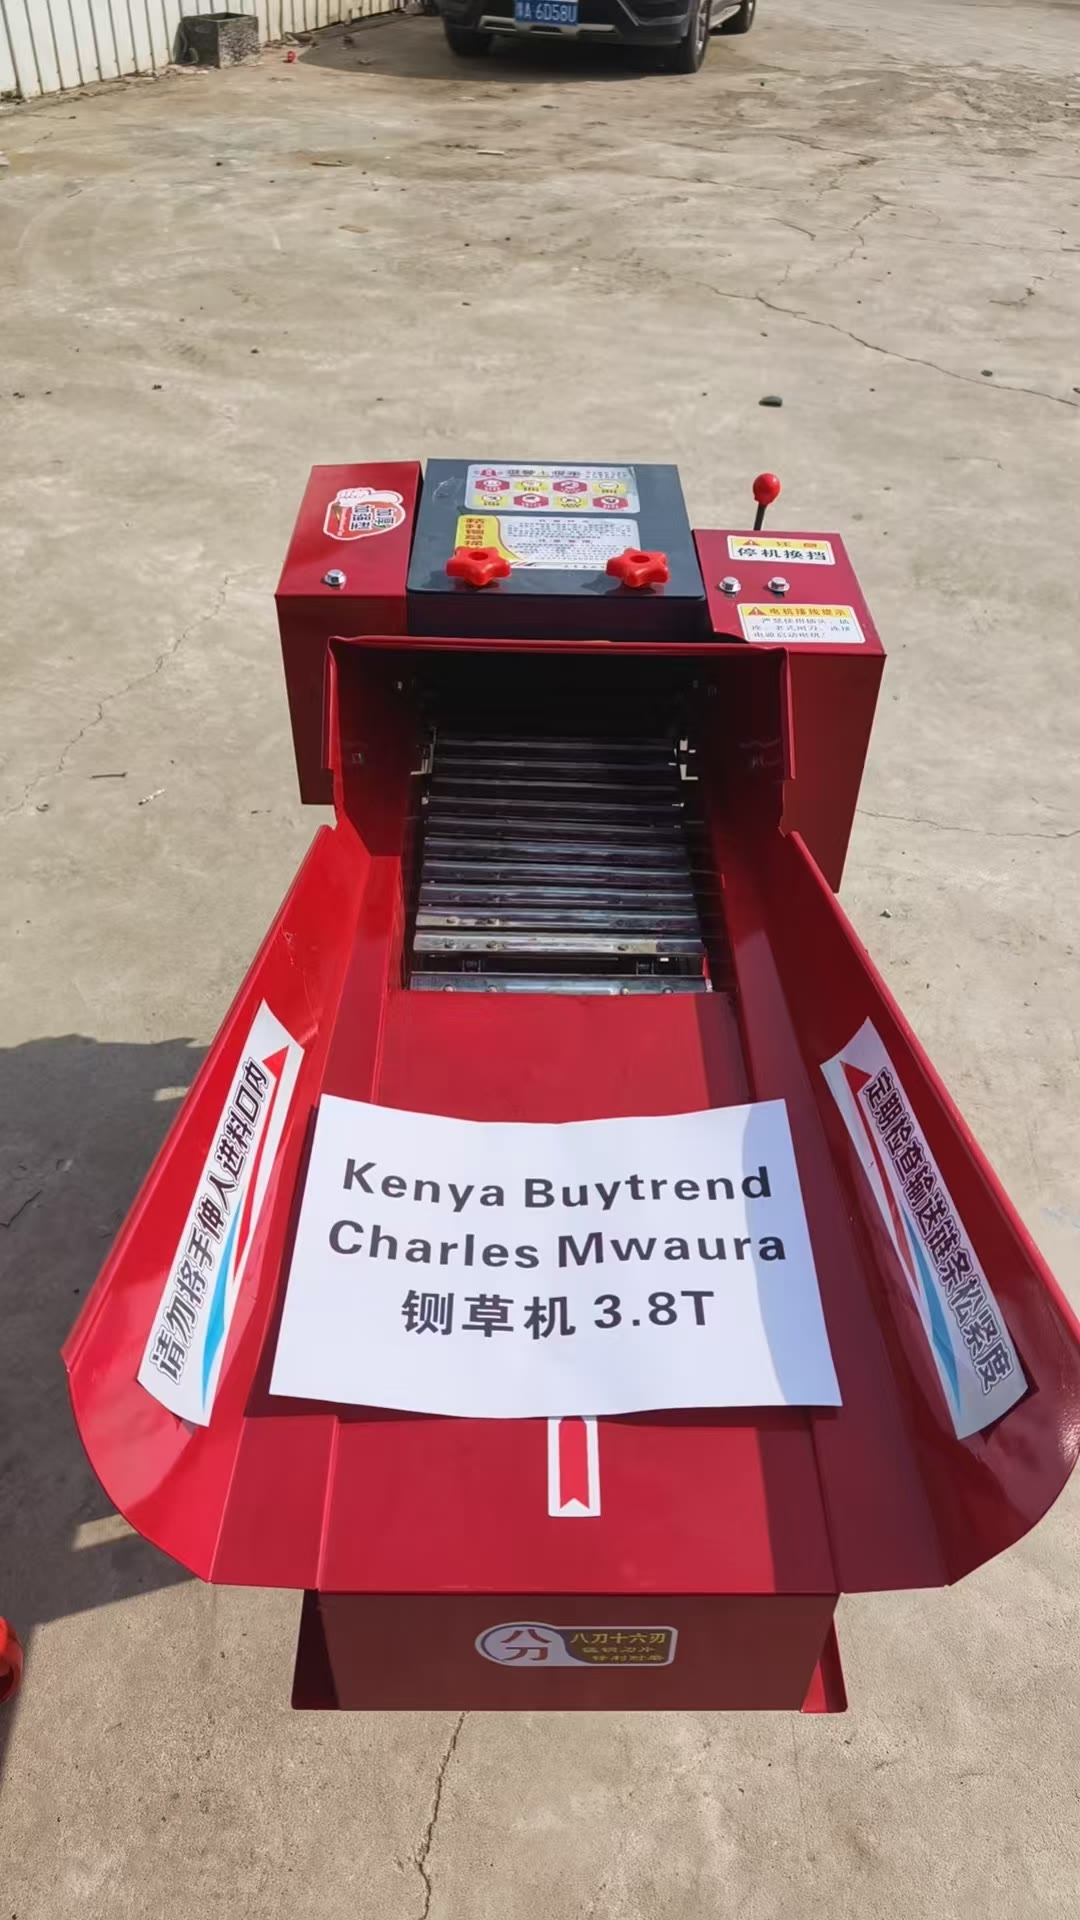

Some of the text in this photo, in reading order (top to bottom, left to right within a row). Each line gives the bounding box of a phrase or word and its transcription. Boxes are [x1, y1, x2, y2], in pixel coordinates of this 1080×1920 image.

[737, 547, 827, 561] 停机换挡
[343, 1158, 772, 1212] Kenya Buytrend
[328, 1219, 787, 1269] Charles Mwaura
[864, 1067, 1014, 1396] 定期检查输送链条松紧度
[401, 1289, 715, 1340] 铡草机 3.8T
[569, 1632, 666, 1644] 八刀十六刃
